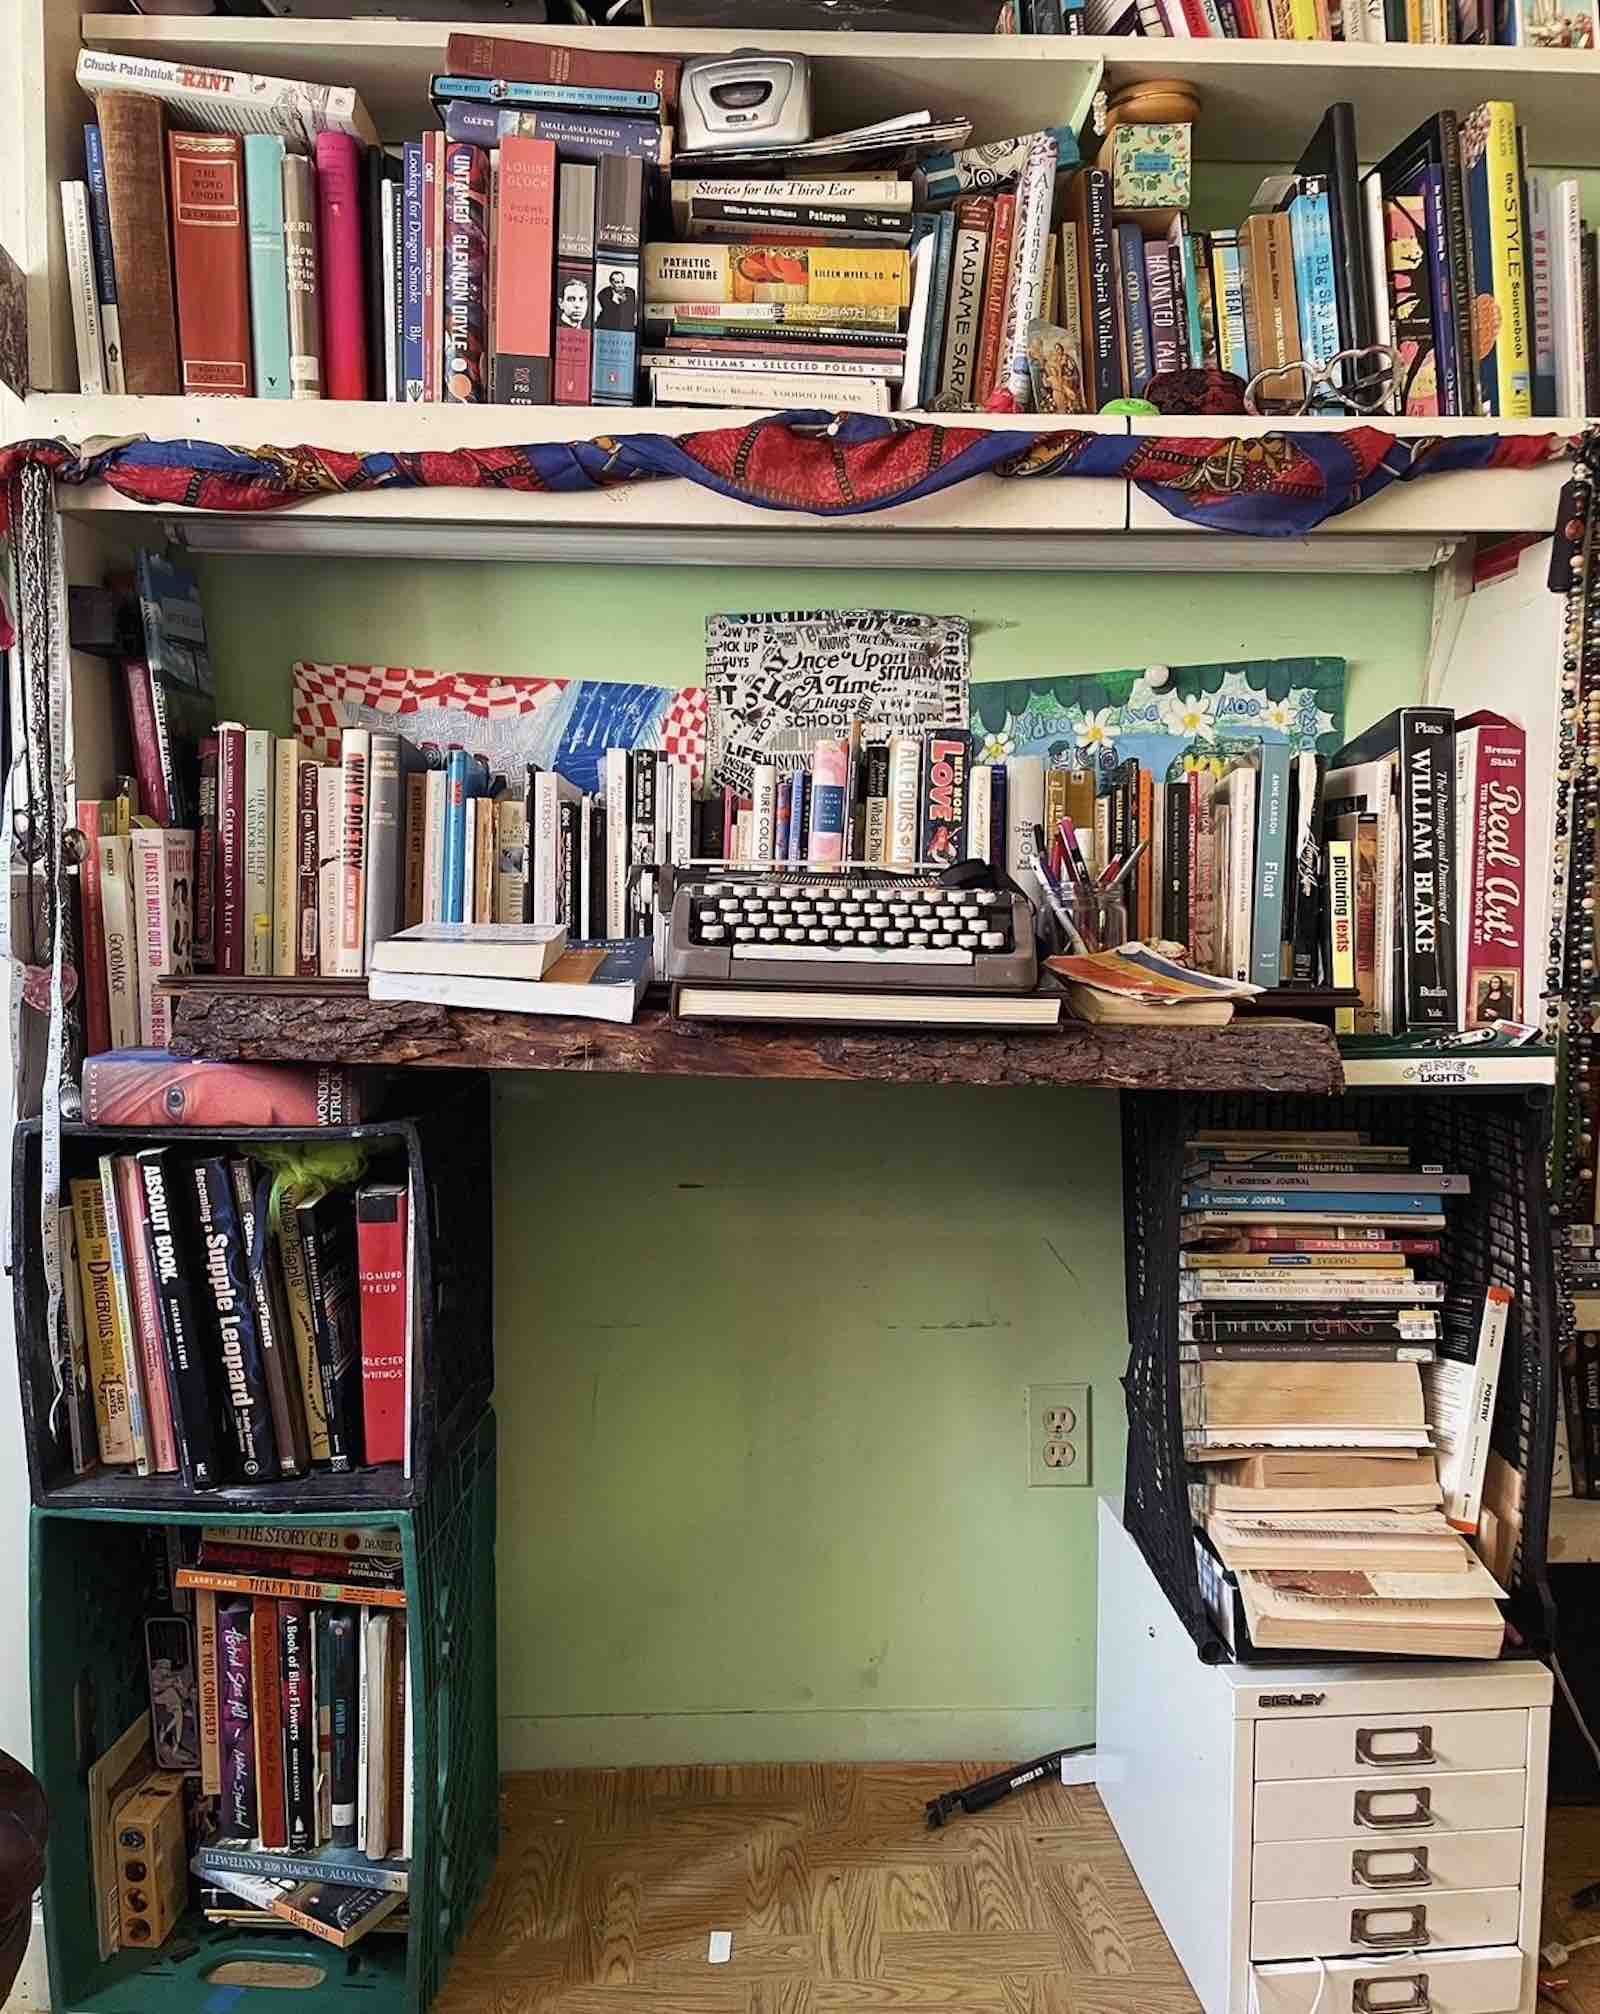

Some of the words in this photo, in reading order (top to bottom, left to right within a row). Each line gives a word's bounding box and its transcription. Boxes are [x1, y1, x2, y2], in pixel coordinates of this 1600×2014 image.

[83, 57, 117, 73] Chuck
[180, 66, 235, 92] RANT
[405, 150, 421, 198] Looking
[453, 154, 470, 223] UNTAMED
[695, 181, 741, 196] Stories
[743, 181, 762, 197] for
[764, 182, 783, 196] the
[786, 182, 826, 197] Third
[828, 182, 856, 197] Ear
[1504, 171, 1516, 193] the
[407, 200, 421, 219] for
[808, 209, 847, 223] Paterson
[1090, 169, 1107, 236] Claiming
[405, 220, 421, 264] Dragon
[1093, 238, 1108, 262] the
[1503, 197, 1522, 278] STYLE
[452, 234, 470, 302] GLENNON
[658, 268, 719, 281] LITERATURE
[662, 256, 712, 268] PATHETIC
[988, 237, 1009, 313] KABBALAH
[1313, 254, 1330, 287] Big
[408, 265, 421, 304] Smoke
[956, 235, 981, 335] MADAME
[1093, 262, 1111, 304] Spirit
[1126, 271, 1140, 301] GOD
[1146, 255, 1175, 328] HAUNTED
[1534, 228, 1552, 356] WONDERBOOK
[1226, 289, 1242, 317] BEAT
[1317, 289, 1334, 321] Sky
[406, 325, 421, 345] Bly
[453, 305, 468, 350] DOYLE
[1095, 307, 1114, 359] Within
[1511, 281, 1524, 359] Sourcebook
[687, 358, 745, 370] WILLIAMS
[762, 361, 819, 372] SELECTED
[824, 362, 865, 374] POEMS
[1131, 328, 1146, 380] WOMAN
[744, 641, 759, 653] UP
[842, 647, 906, 672] Upon
[304, 766, 316, 807] Writers
[347, 758, 365, 798] WHY
[930, 740, 966, 821] LOVE
[953, 756, 965, 786] NEED
[1270, 773, 1279, 798] ANNE
[1436, 771, 1447, 791] The
[677, 780, 689, 817] Stephen
[760, 785, 772, 814] PURE
[897, 780, 915, 833] FOURS
[953, 787, 966, 821] MORE
[1410, 748, 1433, 861] WILLIAM
[1480, 782, 1488, 803] THE
[543, 785, 552, 840] PATERSON
[676, 817, 688, 840] King
[870, 800, 883, 828] What
[1268, 799, 1278, 835] CARSON
[1486, 780, 1522, 868] Real
[224, 807, 236, 868] GERTRUDE
[346, 803, 364, 872] POETRY
[871, 828, 882, 837] is
[1475, 804, 1487, 890] PAINT-BY-NUMBER
[145, 852, 162, 884] DYKES
[1438, 842, 1449, 862] and
[146, 884, 160, 898] TO
[225, 873, 233, 897] AND
[255, 873, 266, 888] OF
[1262, 861, 1279, 899] Float
[1334, 856, 1351, 916] picturing
[146, 898, 162, 926] WATCH
[224, 902, 235, 936] ALICE
[1413, 871, 1436, 954] BLAKE
[1475, 891, 1484, 917] BOOK
[1482, 876, 1520, 949] Art!
[147, 927, 163, 950] OUT
[1336, 919, 1352, 953] texts
[1473, 929, 1482, 946] KIT
[148, 950, 164, 968] FOR
[1401, 1060, 1480, 1080] CAMEL
[1419, 1073, 1466, 1083] LIGHTS
[317, 1066, 330, 1127] WONDER
[329, 1071, 344, 1124] STRUCK
[142, 1165, 168, 1232] ABSOLUT
[193, 1167, 212, 1223] Becoming
[203, 1224, 213, 1233] a
[204, 1233, 235, 1312] Supple
[88, 1261, 116, 1339] DANGEROUS
[169, 1298, 182, 1335] RICHARD
[177, 1345, 189, 1371] LEWIS
[259, 1302, 274, 1349] Plants
[219, 1316, 255, 1407] Leopard
[1480, 1383, 1493, 1423] POETRY
[236, 1527, 264, 1542] THE
[265, 1528, 306, 1546] STORY
[309, 1530, 327, 1547] OF
[329, 1532, 338, 1549] B
[248, 1577, 284, 1594] TICKET
[287, 1582, 300, 1595] TO
[201, 1625, 214, 1647] ARE
[286, 1615, 297, 1625] A
[287, 1625, 300, 1655] Book
[202, 1653, 217, 1676] YOU
[287, 1655, 301, 1669] of
[286, 1670, 300, 1695] Blue
[1258, 1692, 1326, 1707] BISLEY
[286, 1696, 301, 1742] Flowers
[204, 1850, 263, 1872] LLEWELLYN'S
[280, 1862, 326, 1879] MAGICAL
[328, 1866, 378, 1885] ALMANAC
